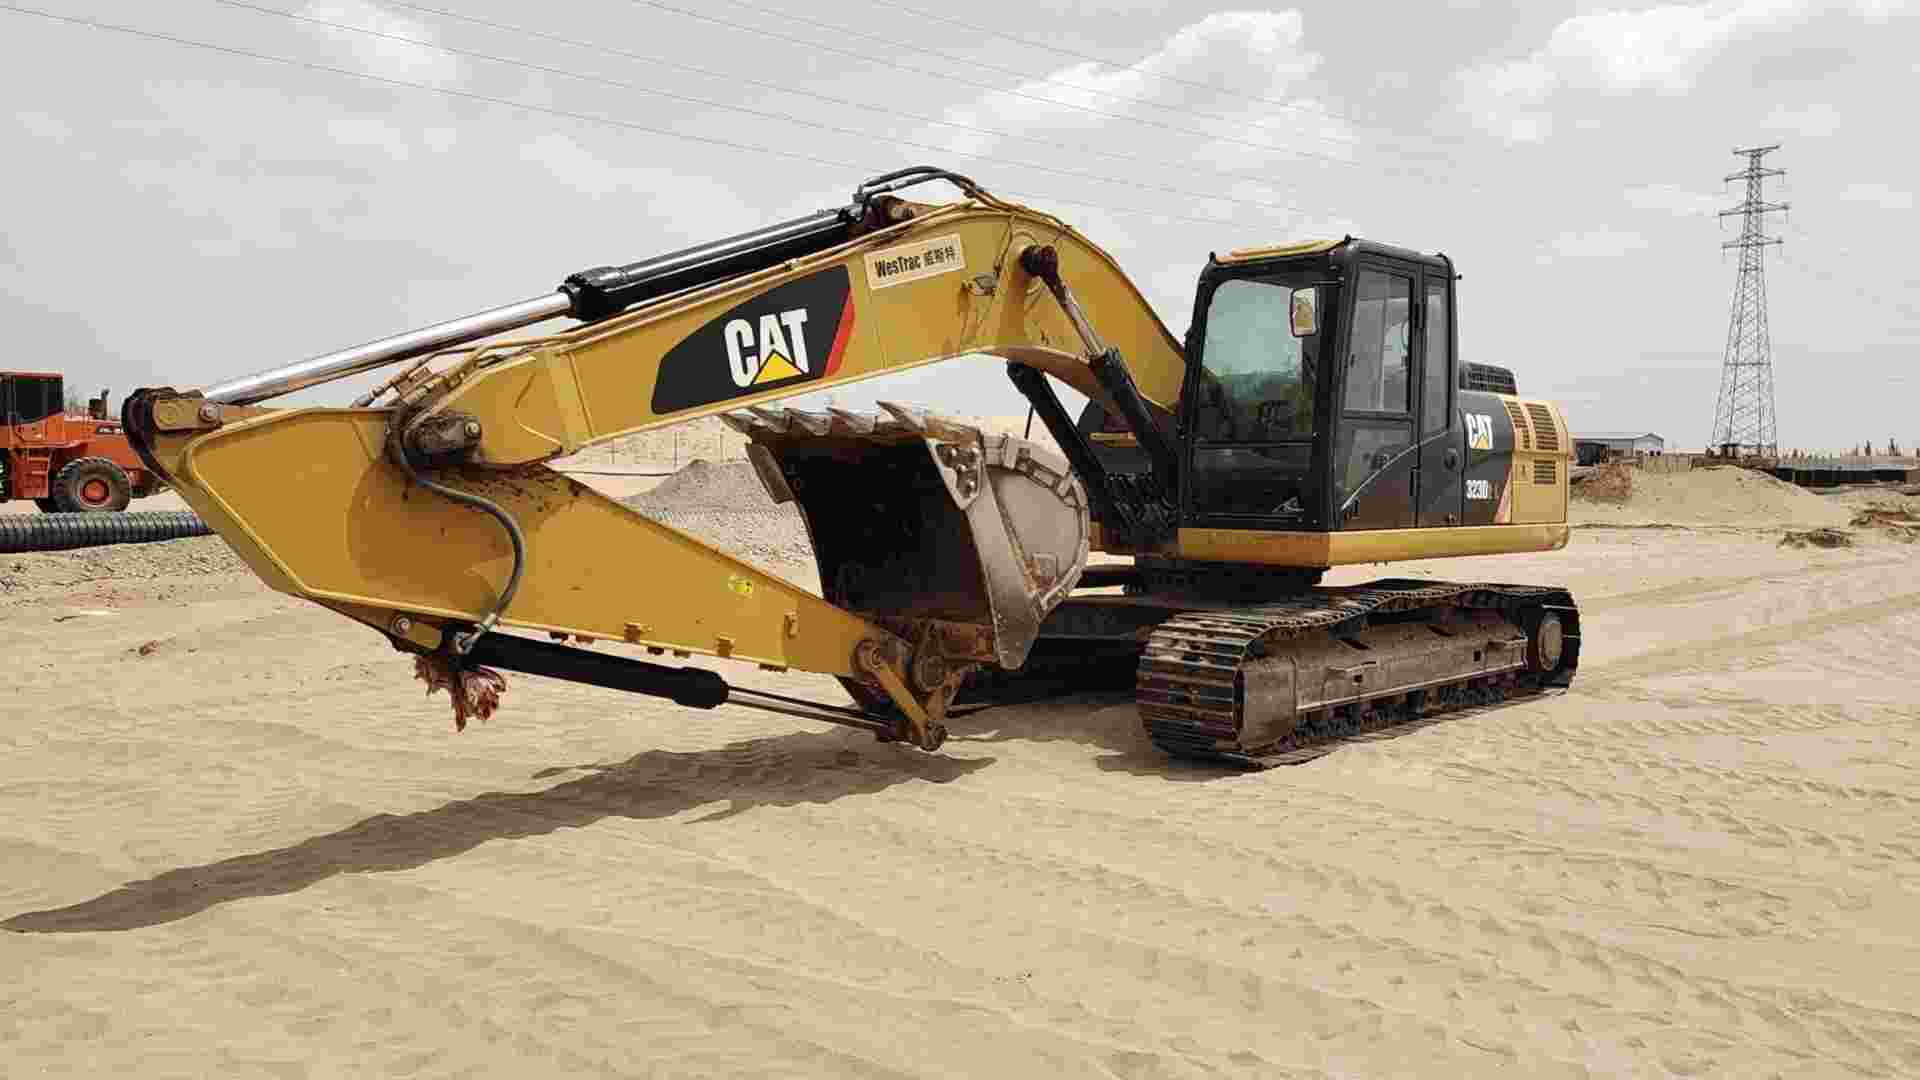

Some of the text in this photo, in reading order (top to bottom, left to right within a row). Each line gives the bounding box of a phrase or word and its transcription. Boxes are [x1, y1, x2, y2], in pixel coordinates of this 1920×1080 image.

[874, 255, 921, 278] WesTrac
[724, 308, 809, 388] CAT
[1465, 413, 1493, 449] CAT
[1465, 480, 1488, 499] 323D
